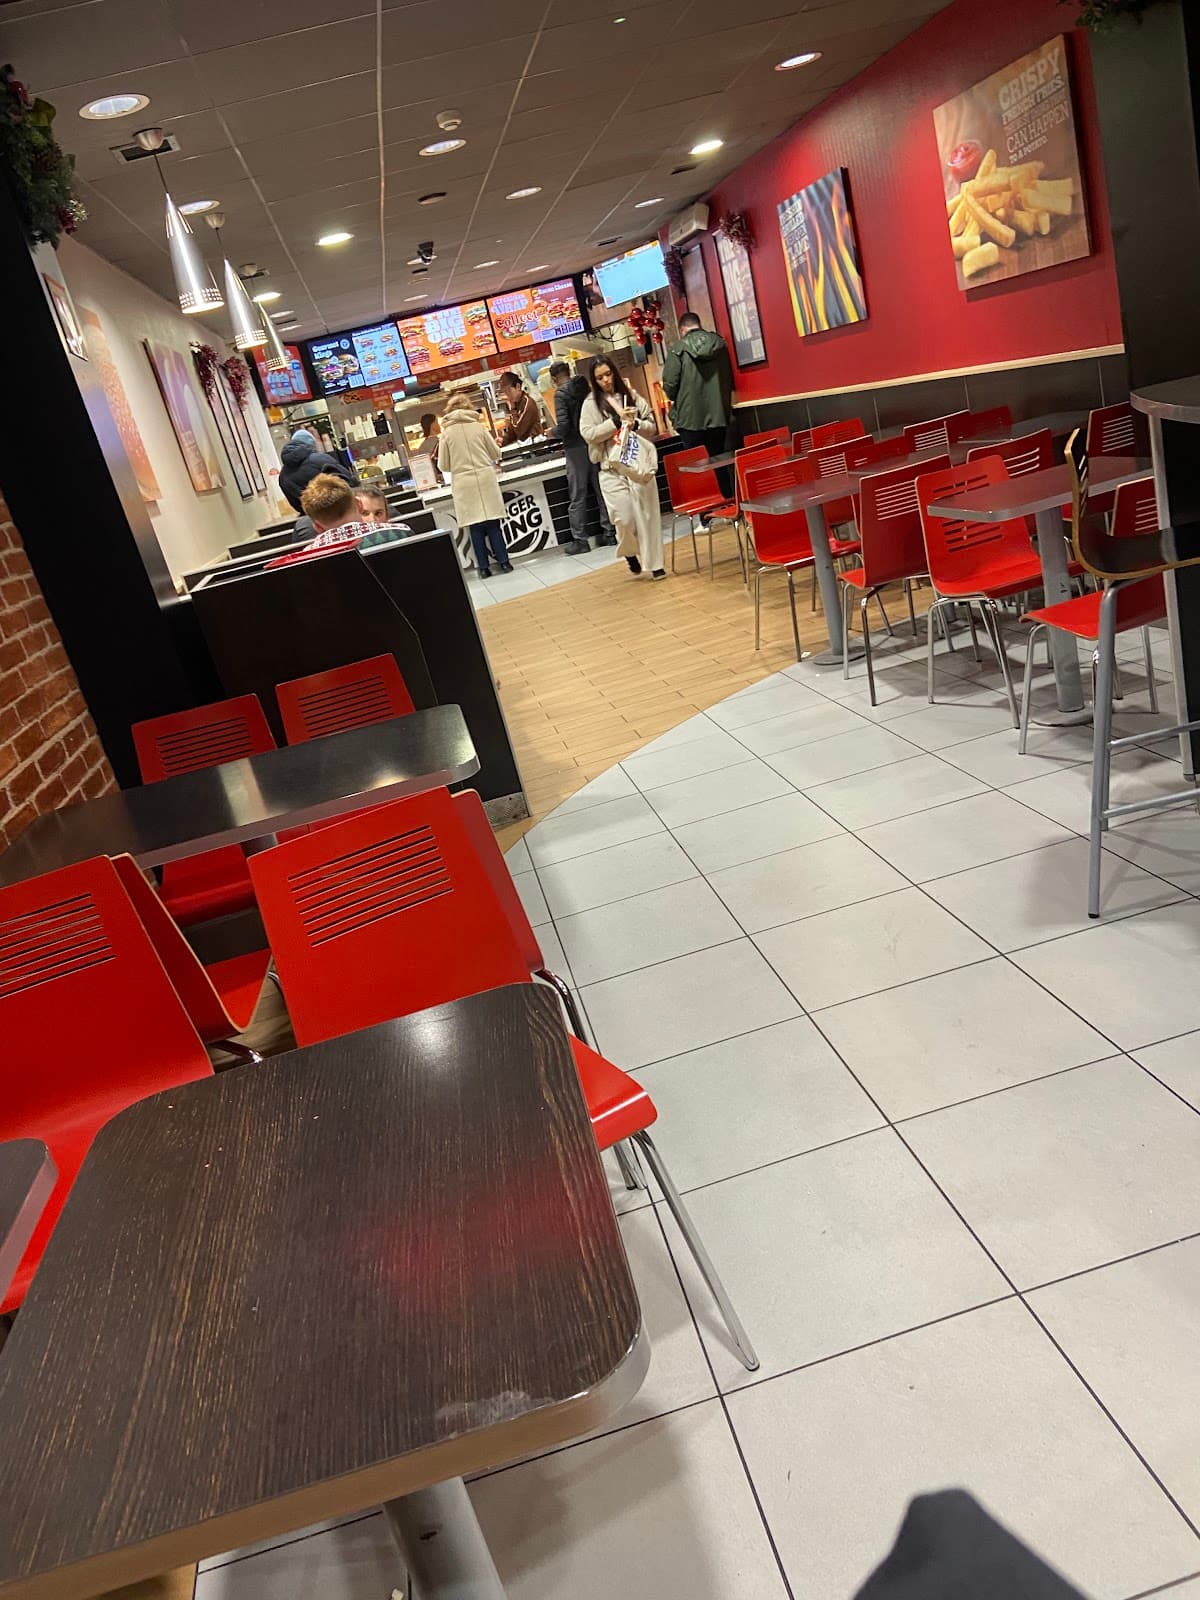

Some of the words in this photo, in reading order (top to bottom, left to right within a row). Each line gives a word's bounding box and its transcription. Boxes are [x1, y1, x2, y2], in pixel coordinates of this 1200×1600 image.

[998, 48, 1060, 110] CRISPY
[1001, 95, 1035, 125] FRENCH
[1007, 127, 1029, 153] CAN
[1028, 100, 1070, 140] HAPPEN
[1018, 149, 1024, 159] A
[492, 298, 528, 315] WRAP
[425, 315, 465, 335] BIG
[495, 310, 539, 330] Collect
[427, 327, 467, 343] ONE
[506, 495, 537, 517] GER
[502, 507, 543, 545] ING
